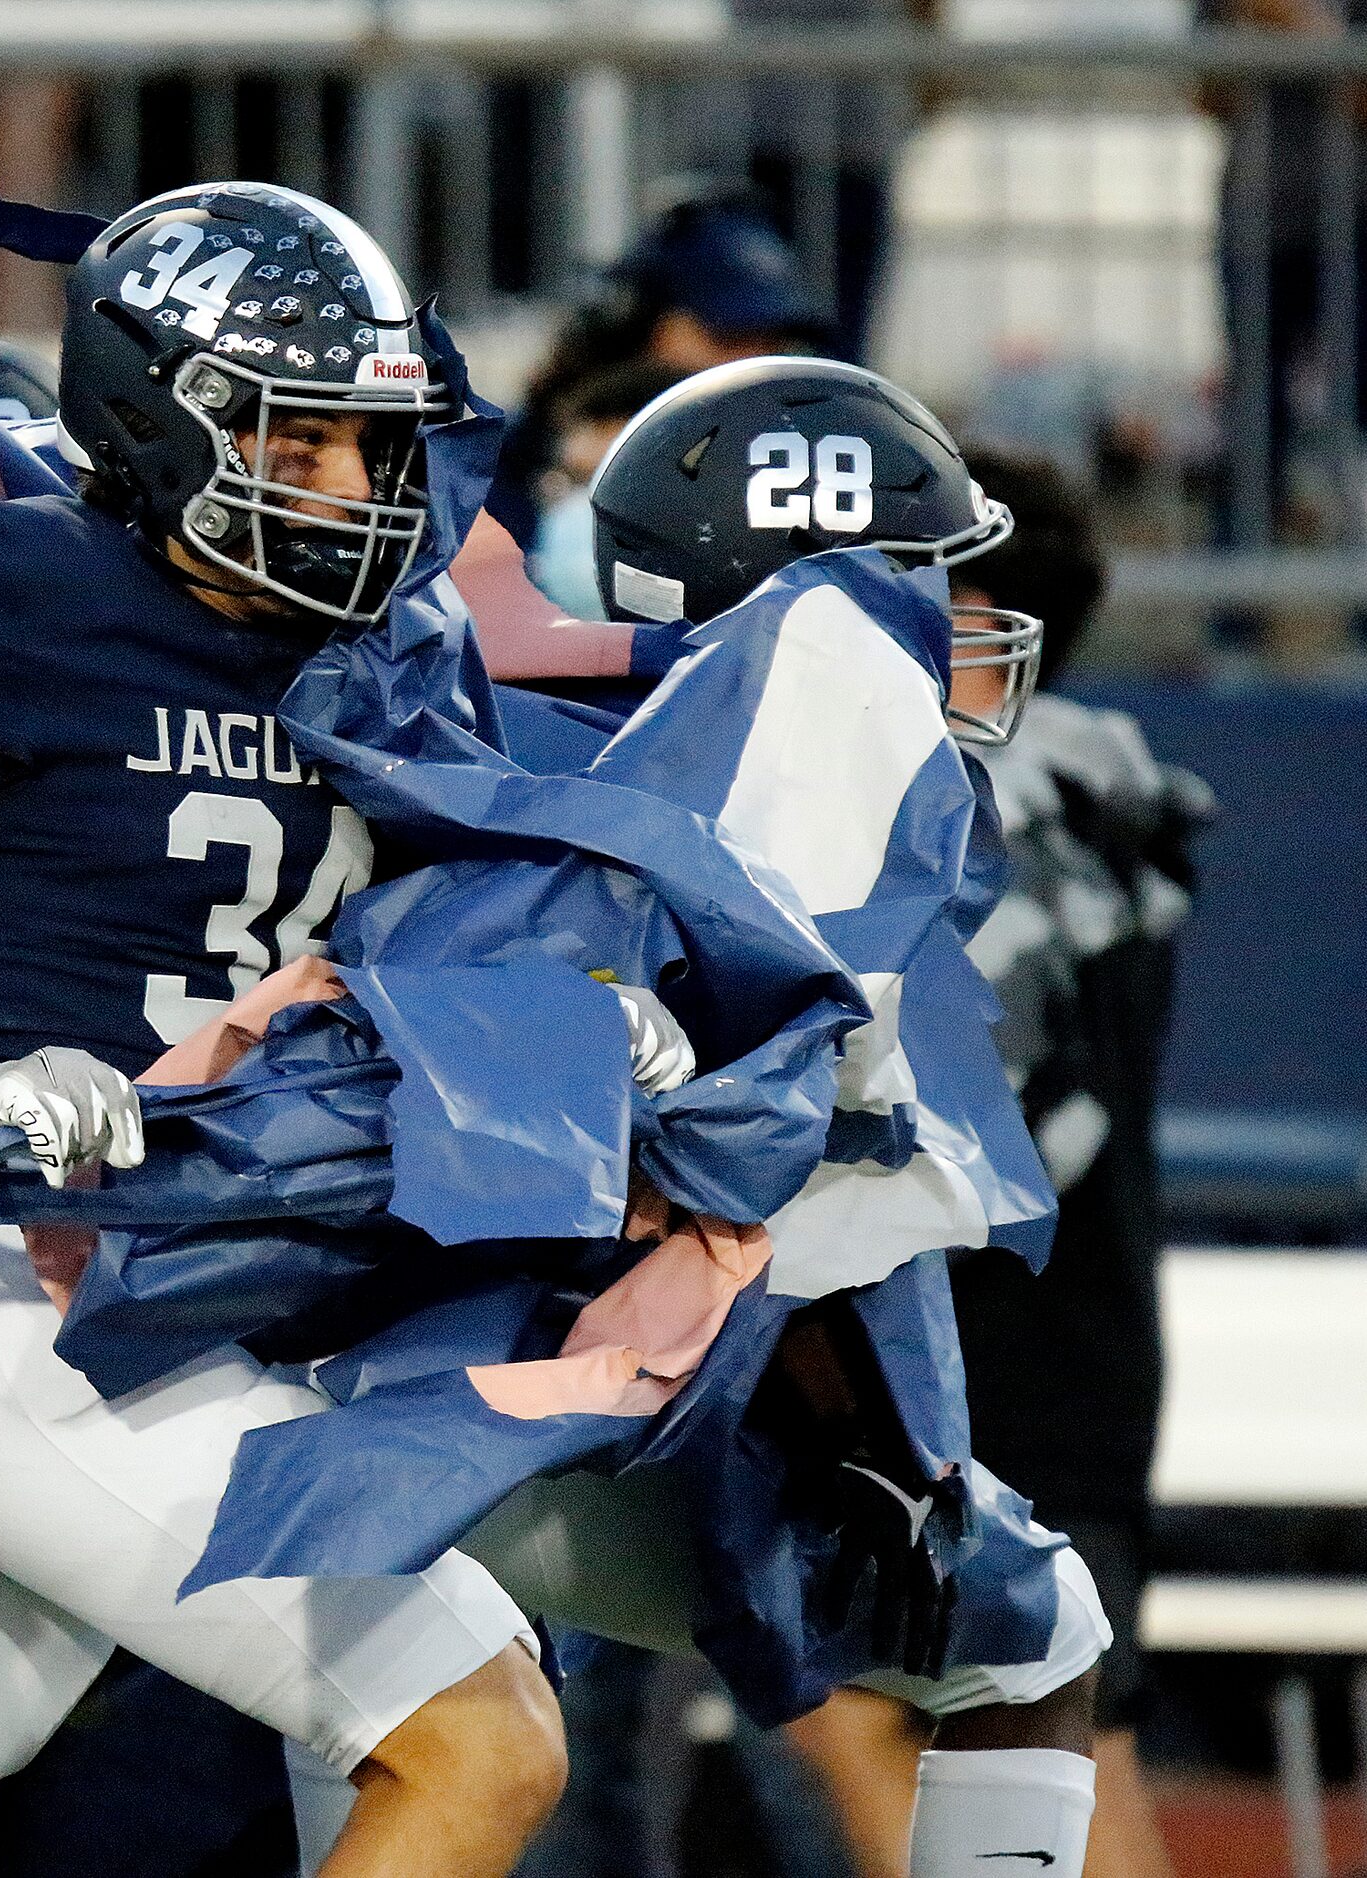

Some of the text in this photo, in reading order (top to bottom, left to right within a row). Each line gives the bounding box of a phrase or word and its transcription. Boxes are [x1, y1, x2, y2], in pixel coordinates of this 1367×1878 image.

[120, 221, 256, 342] 34
[373, 359, 424, 378] Riddell
[747, 431, 874, 532] 28
[126, 706, 320, 785] JAGU
